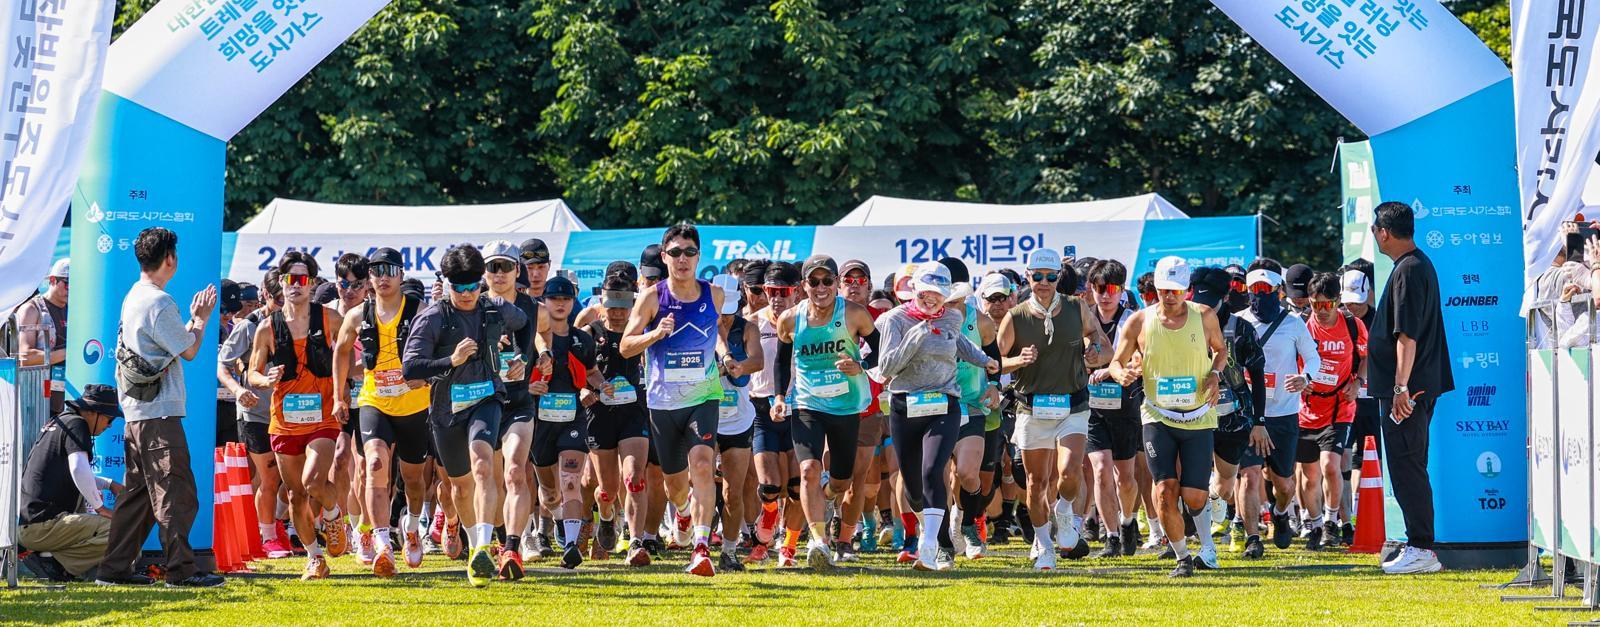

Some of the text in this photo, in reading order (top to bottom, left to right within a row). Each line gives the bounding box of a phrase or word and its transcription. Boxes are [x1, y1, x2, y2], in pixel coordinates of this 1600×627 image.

[218, 10, 278, 62] 희망을
[249, 11, 323, 73] 도시가스
[1274, 5, 1346, 70] 도시가스
[1337, 21, 1377, 60] 잇는
[129, 190, 147, 200] 주최
[1453, 185, 1471, 195] 주최
[105, 211, 194, 222] 한국도시가스협회
[1432, 206, 1512, 217] 한국도시가스협회
[1450, 233, 1503, 245] 동아일보
[711, 240, 797, 261] TRAIL
[895, 239, 953, 263] 12K
[1462, 274, 1480, 284] 협력
[1445, 296, 1499, 306] JOHNBER
[801, 339, 846, 356] AMRC
[1475, 351, 1499, 368] 링티
[1172, 382, 1191, 390] 1043
[1456, 420, 1511, 432] SKYBAY
[1478, 498, 1506, 510] T.O.P
